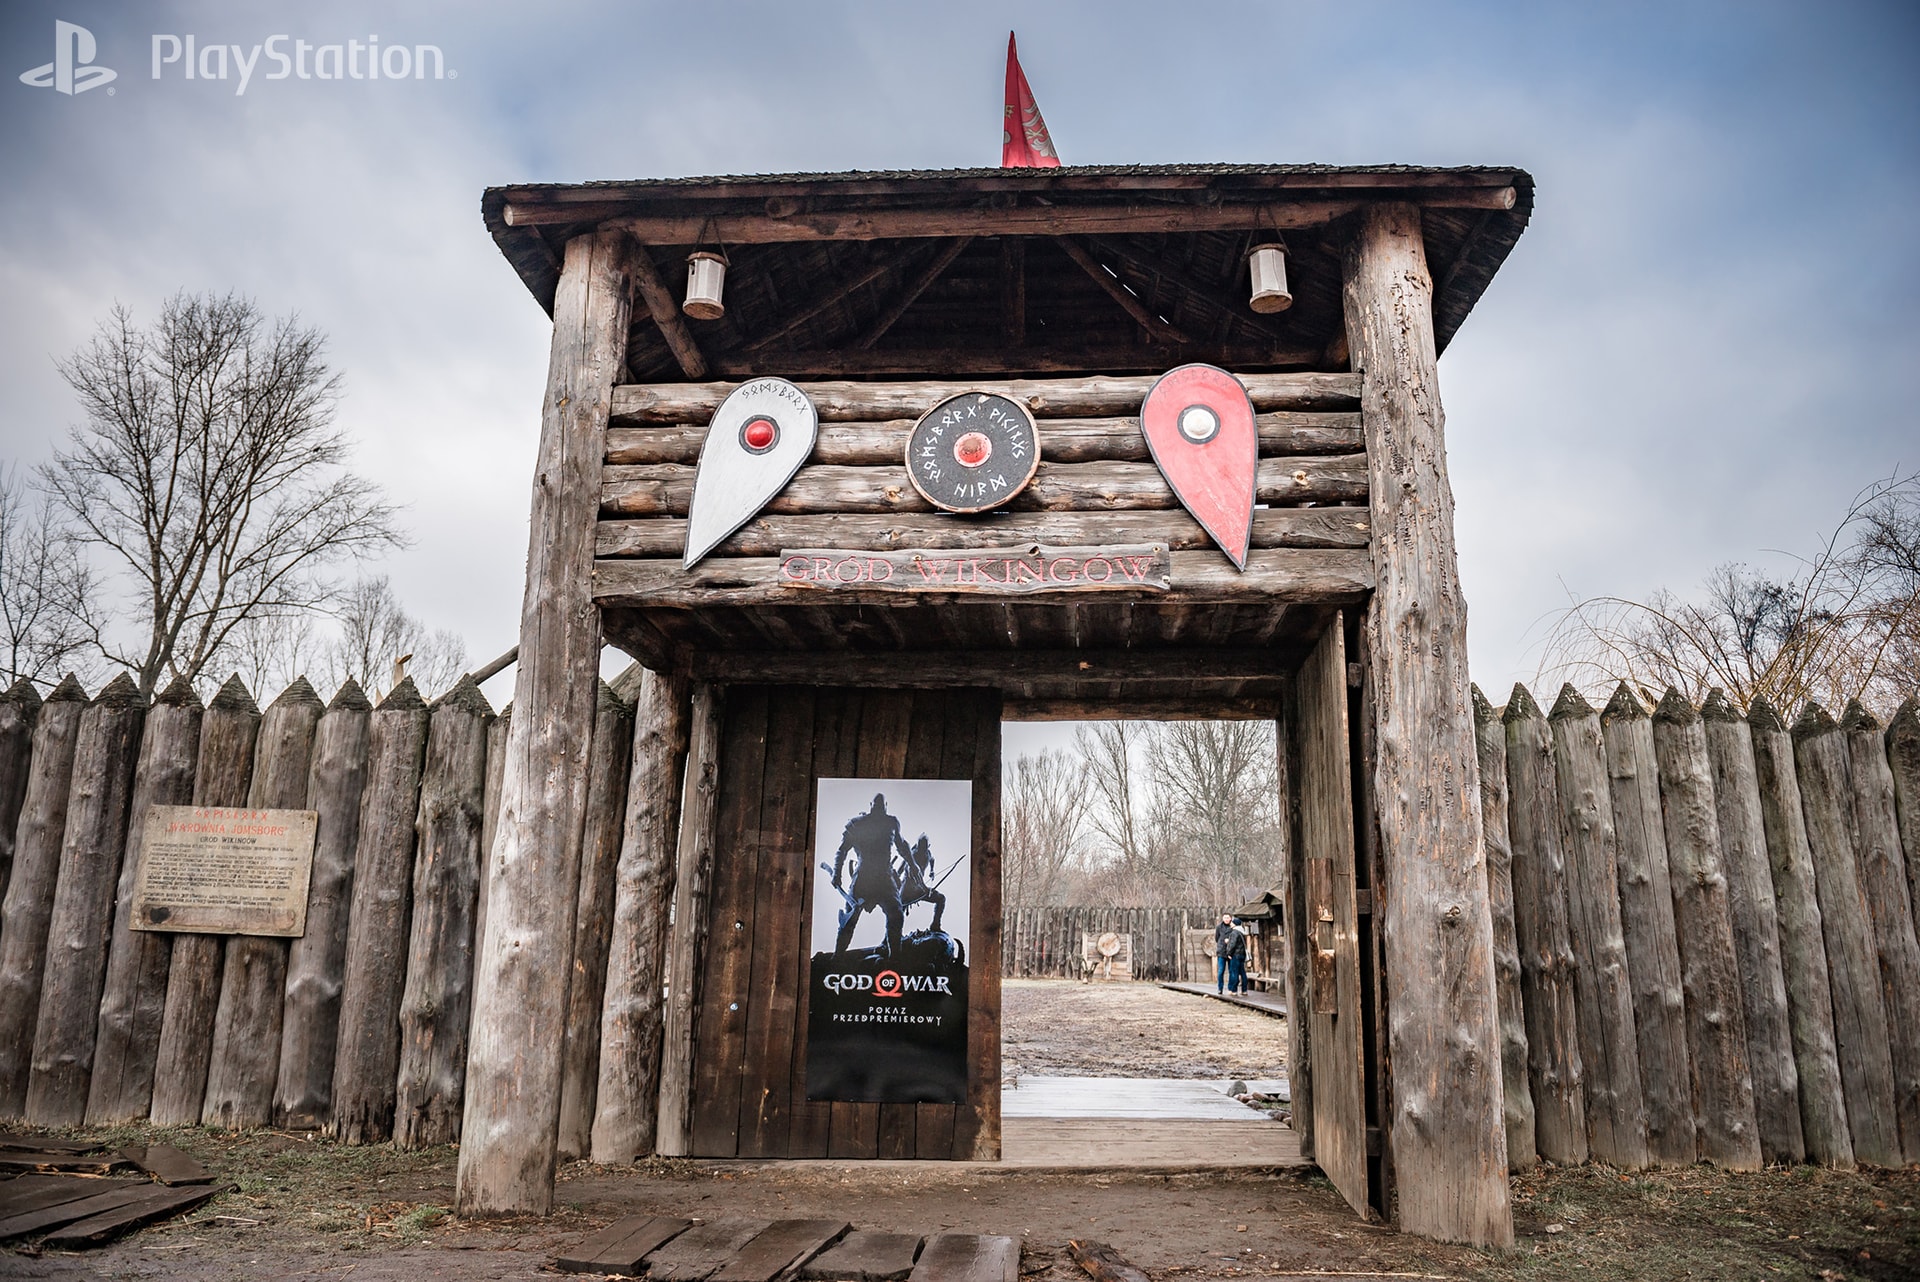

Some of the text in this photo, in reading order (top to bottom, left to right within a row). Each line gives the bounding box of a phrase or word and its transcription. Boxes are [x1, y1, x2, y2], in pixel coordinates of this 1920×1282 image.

[782, 553, 1155, 583] GRÓD WIKINGÓW
[823, 974, 952, 995] GOD OF WAR
[868, 1006, 906, 1015] POKAZ
[832, 1014, 942, 1026] PRZEDPREMIEROWY
